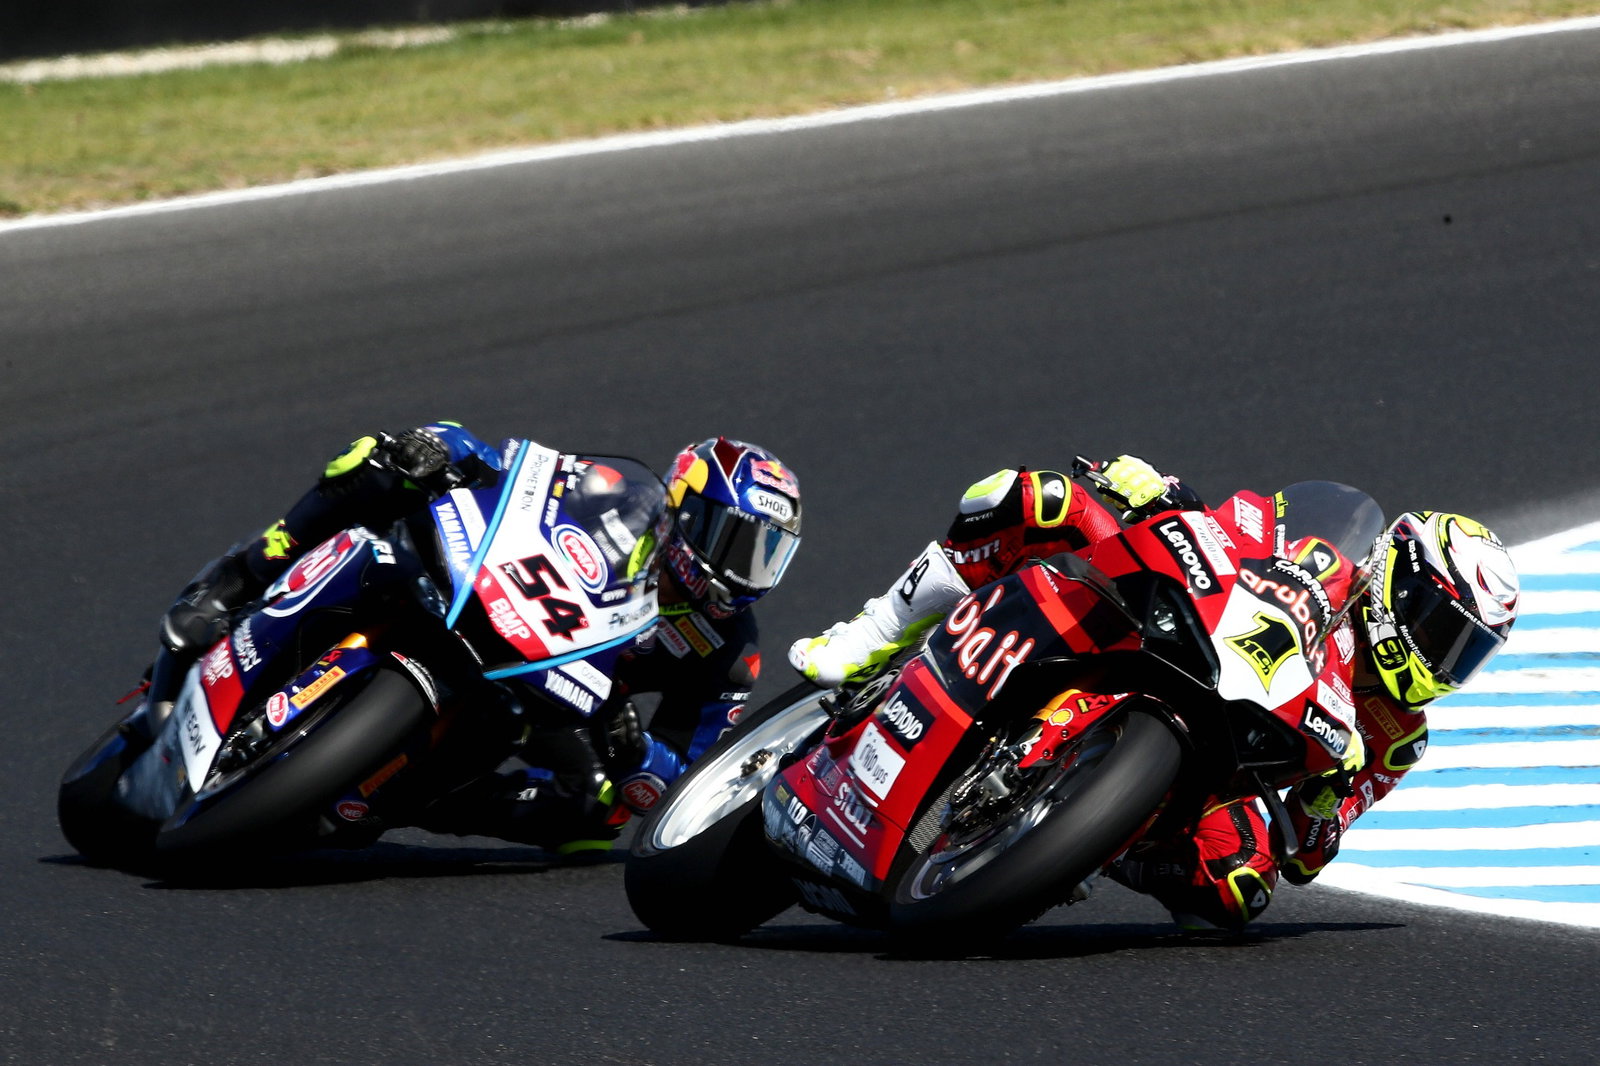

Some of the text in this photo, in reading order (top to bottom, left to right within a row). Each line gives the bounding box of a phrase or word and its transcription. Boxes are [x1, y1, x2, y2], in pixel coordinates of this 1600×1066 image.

[435, 502, 471, 572] YAMAHA
[1159, 521, 1212, 590] Lenovo
[489, 597, 531, 640] BMP
[499, 553, 590, 642] 54
[1224, 611, 1300, 695] 1
[1400, 624, 1433, 668] Motostorm.it
[544, 669, 594, 713] YAMAHA
[884, 691, 923, 740] Lenovo
[1304, 706, 1345, 753] Lenovo
[631, 784, 654, 808] PATA
[1306, 818, 1322, 847] novo
